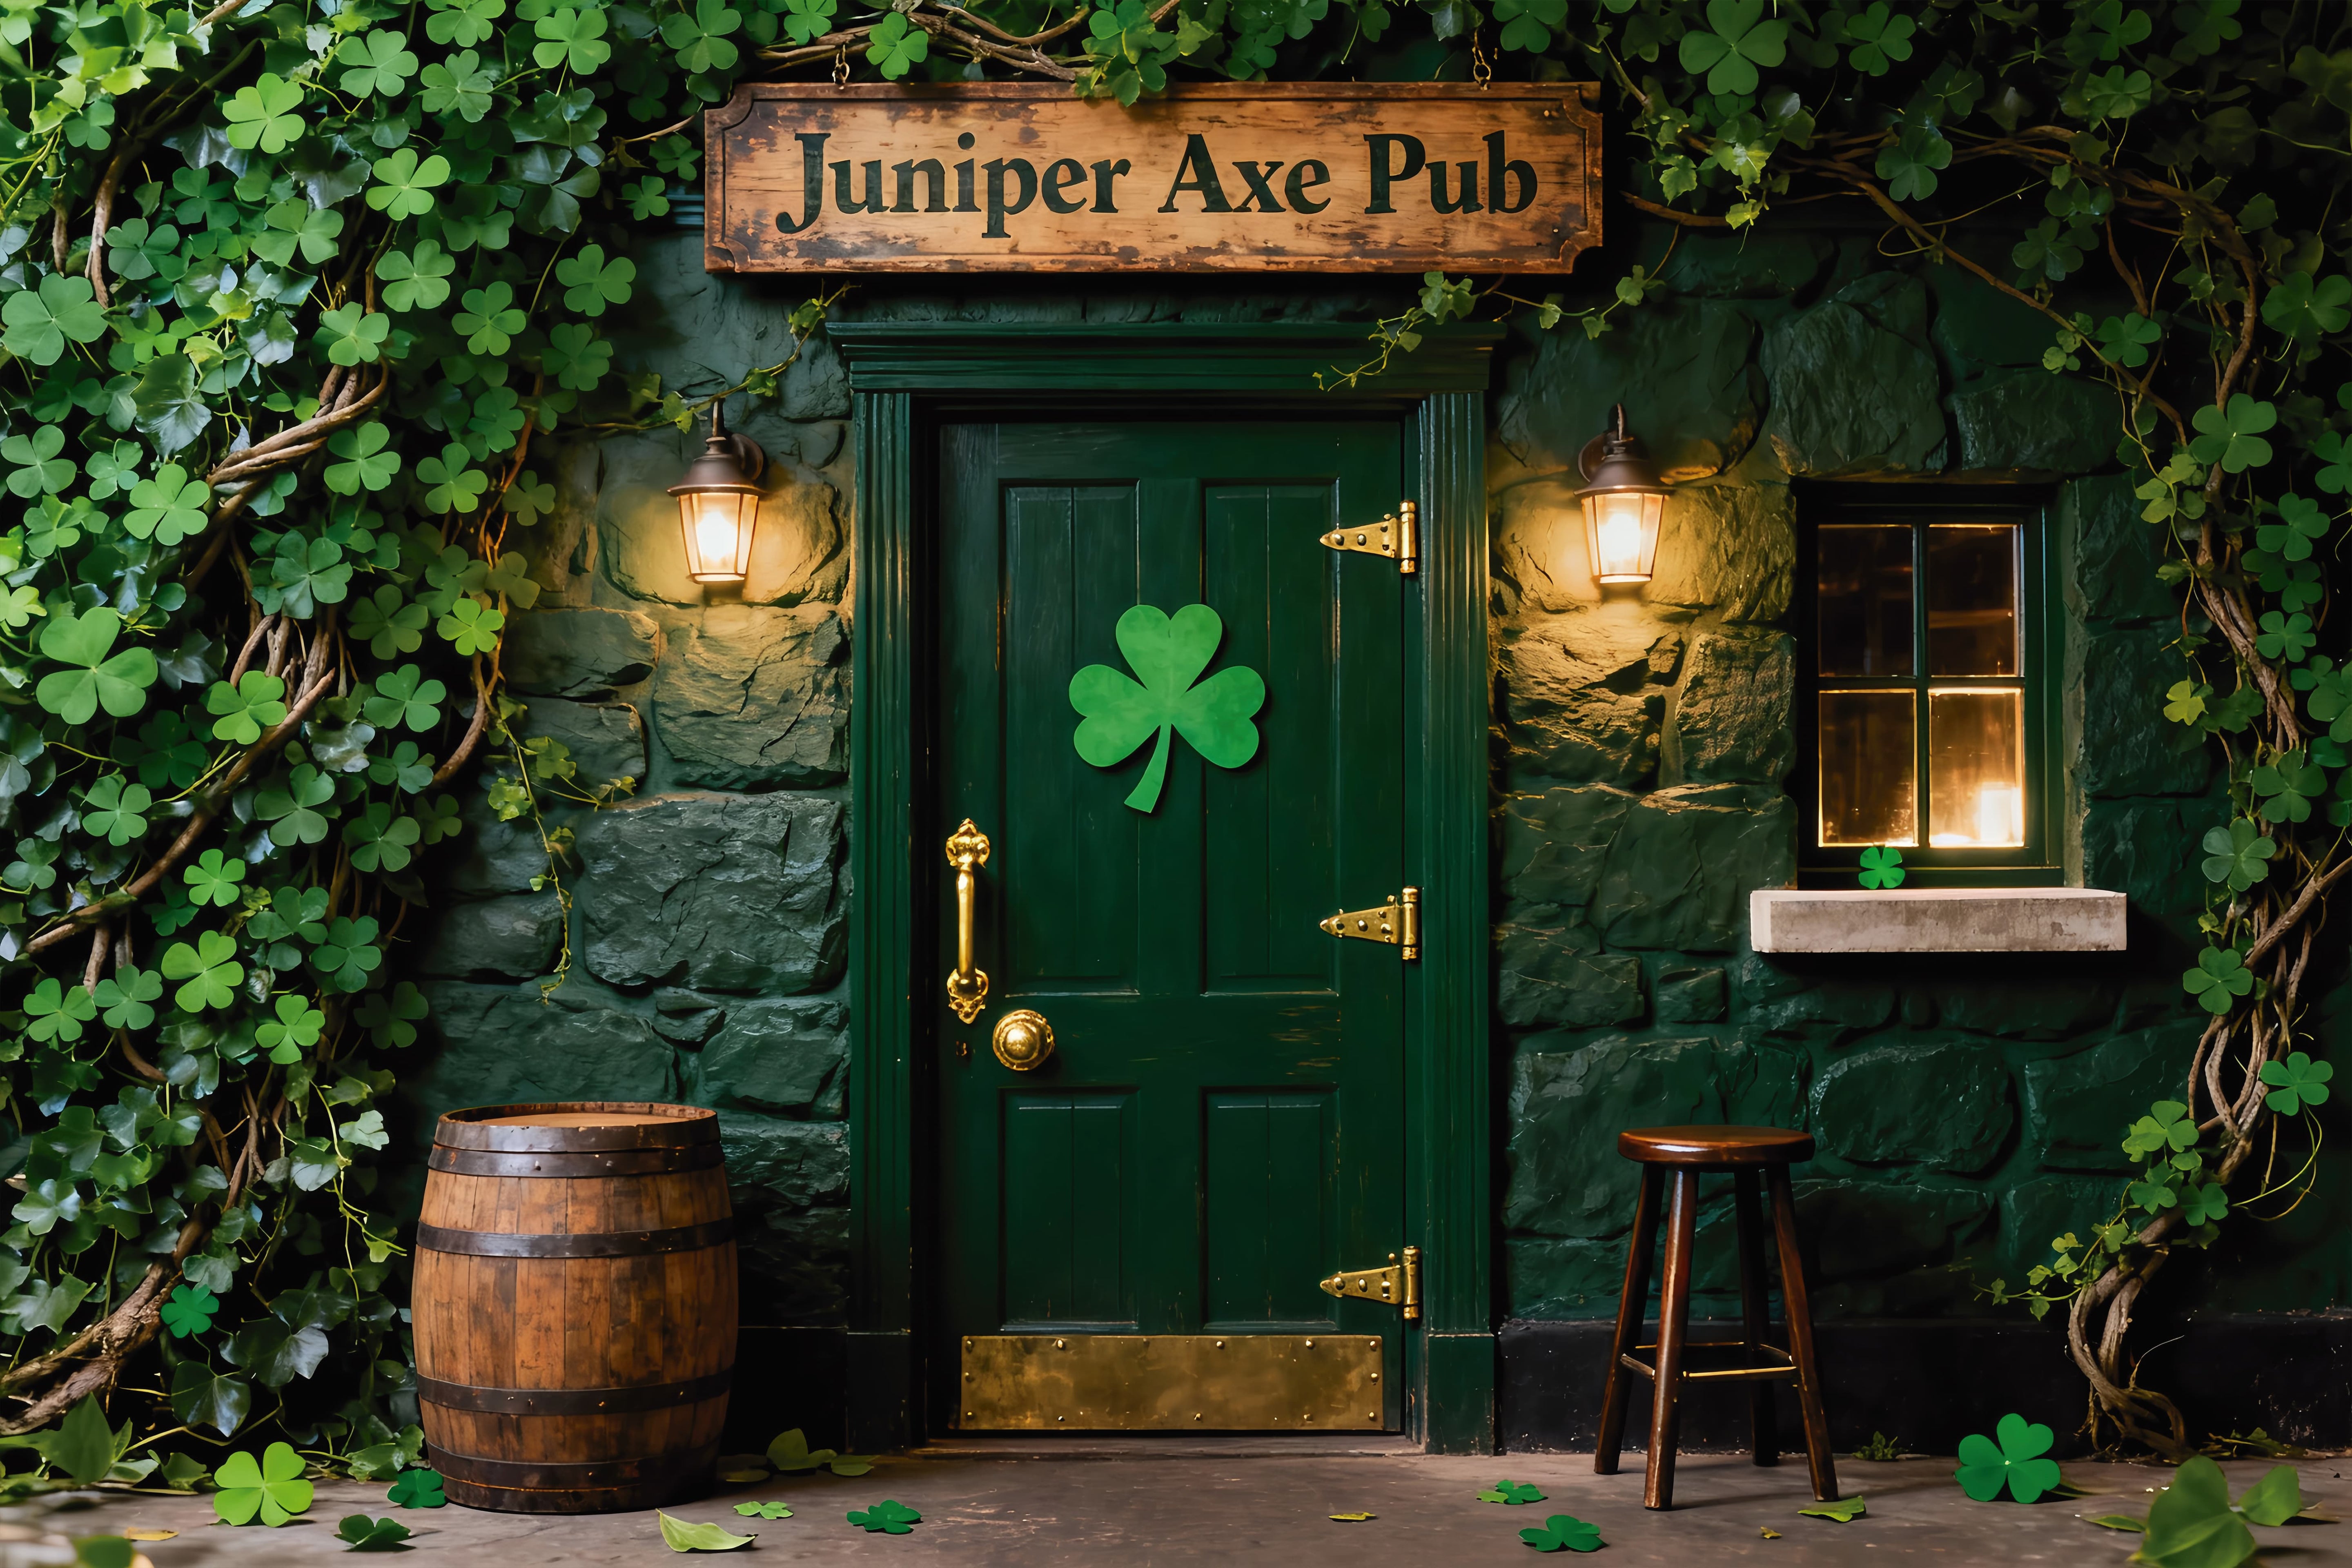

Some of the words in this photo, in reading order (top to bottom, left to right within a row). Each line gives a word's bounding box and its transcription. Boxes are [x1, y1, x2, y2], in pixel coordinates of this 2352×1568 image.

[776, 132, 1131, 239] Juniper
[1157, 133, 1332, 214] Axe
[1363, 130, 1538, 215] Pub
